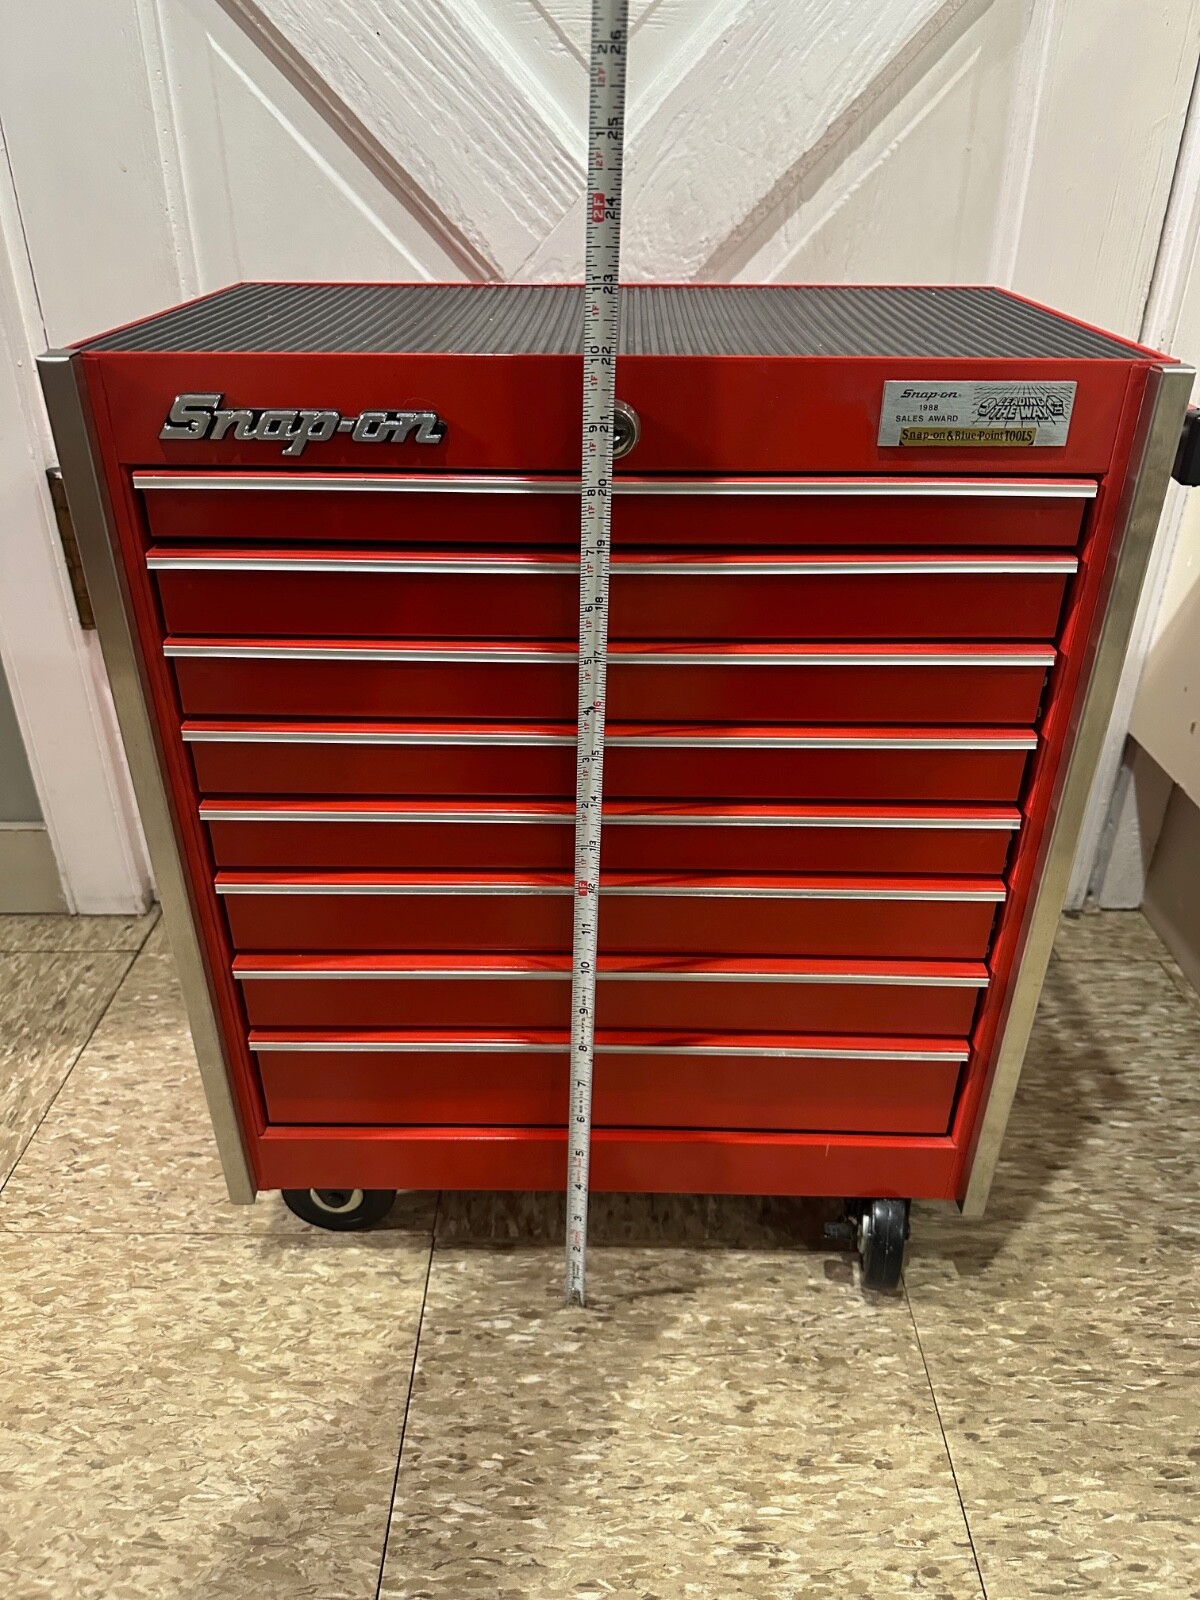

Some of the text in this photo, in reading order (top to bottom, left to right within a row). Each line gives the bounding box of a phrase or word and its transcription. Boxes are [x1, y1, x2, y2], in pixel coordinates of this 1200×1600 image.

[610, 30, 621, 54] 26
[598, 45, 608, 53] 2
[598, 68, 606, 83] 2F
[608, 118, 618, 139] 25
[596, 152, 603, 167] 2F
[593, 199, 604, 218] 2F
[606, 197, 615, 218] 24
[593, 276, 600, 291] 11
[604, 275, 613, 294] 23
[592, 305, 600, 315] 1F
[591, 346, 599, 363] 10
[602, 347, 611, 365] 22
[590, 376, 598, 386] 1F
[901, 389, 957, 401] Snap-on
[997, 396, 1046, 406] LEADING
[989, 405, 1050, 420] THE WAY
[159, 393, 443, 456] Snap-on
[601, 415, 609, 432] 21
[896, 415, 959, 423] SALES AWARD
[946, 430, 954, 441] &
[1005, 430, 1033, 441] TOOLS
[589, 442, 596, 452] 1F
[598, 479, 607, 496] 20
[588, 505, 595, 514] 1F
[597, 540, 605, 554] 19
[587, 565, 594, 573] 1F
[596, 597, 603, 610] 18
[586, 620, 592, 628] 1F
[594, 650, 602, 664] 17
[585, 672, 591, 680] 1F
[593, 701, 601, 713] 16
[584, 722, 590, 730] 1F
[592, 750, 599, 761] 15
[583, 769, 589, 777] 1F
[591, 796, 598, 807] 14
[582, 814, 588, 822] 1F
[589, 840, 597, 851] 13
[581, 858, 587, 866] 1F
[580, 883, 587, 893] 1F
[588, 883, 596, 893] 12
[582, 923, 591, 934] 11
[581, 962, 589, 974] 10
